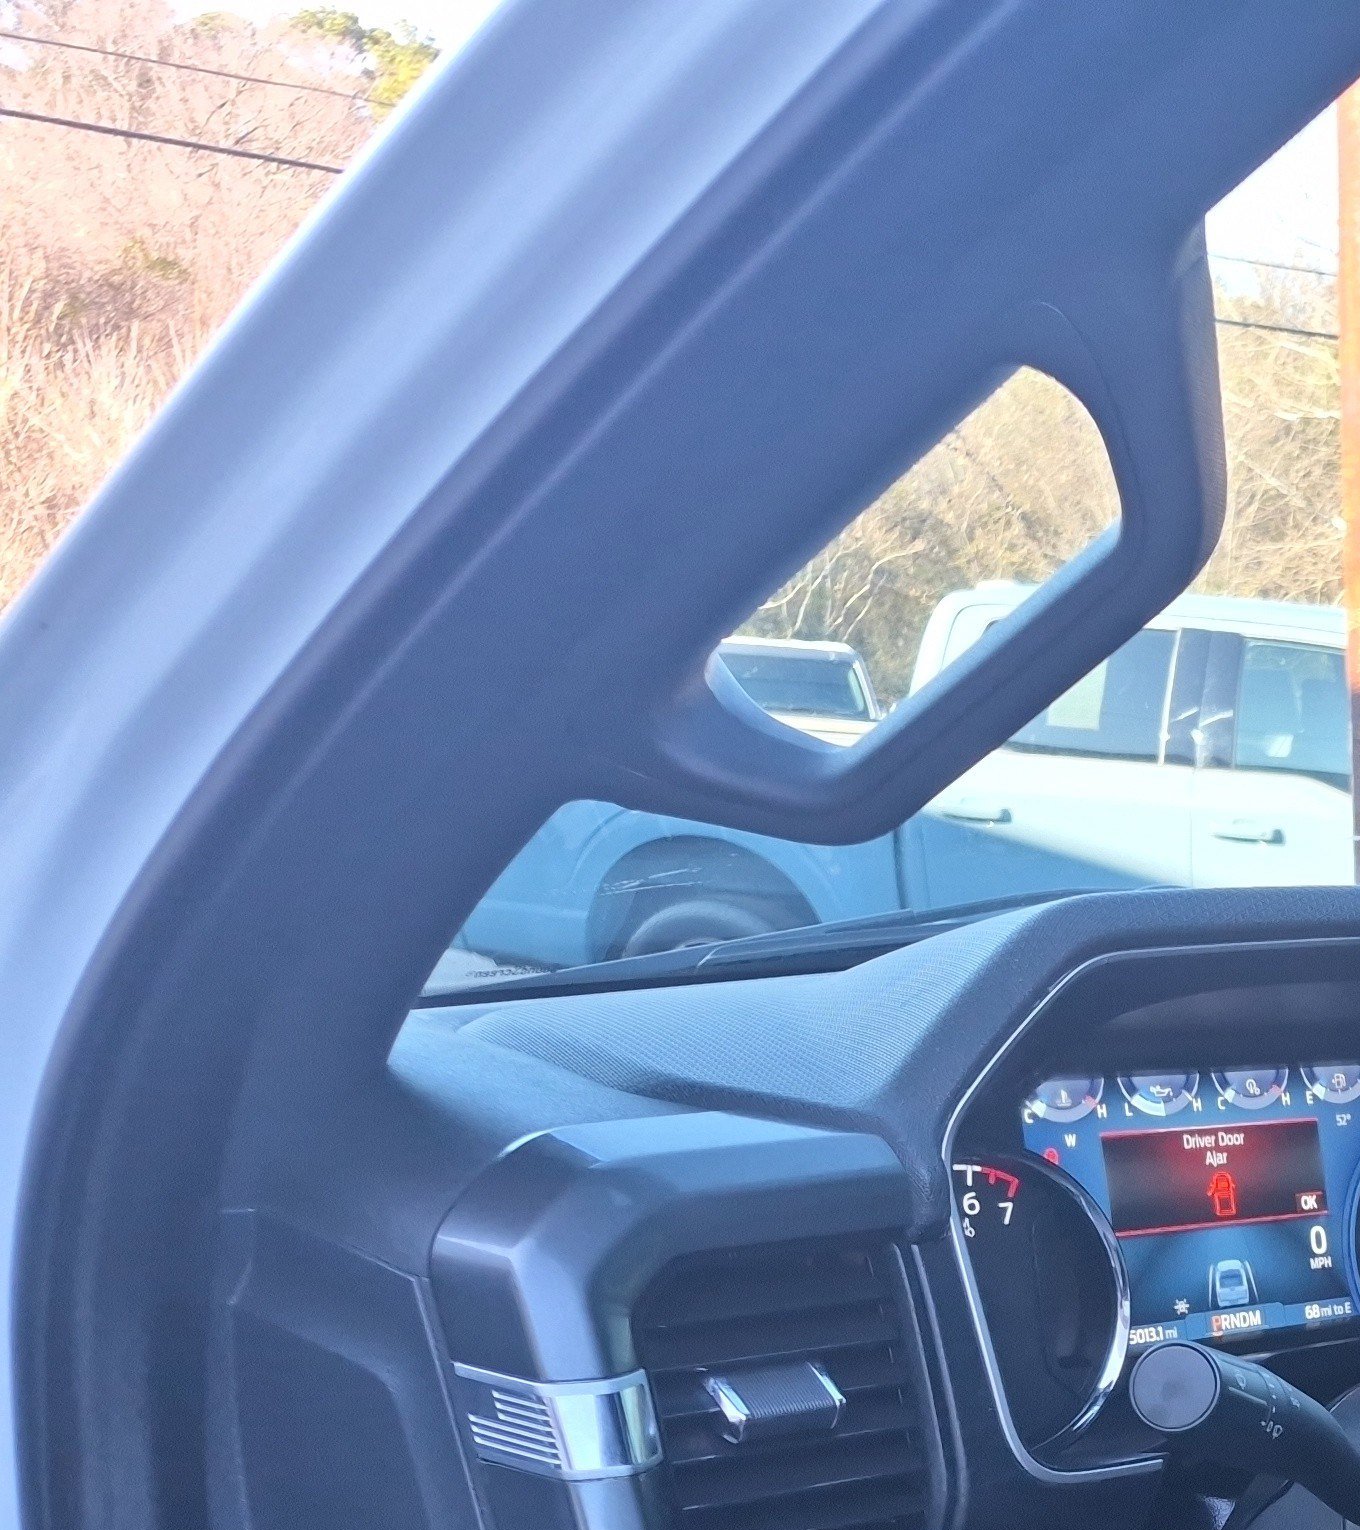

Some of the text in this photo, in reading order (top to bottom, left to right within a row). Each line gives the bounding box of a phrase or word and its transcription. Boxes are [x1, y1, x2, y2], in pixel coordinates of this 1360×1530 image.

[1192, 1097, 1203, 1112] H
[1217, 1096, 1226, 1110] C
[1281, 1091, 1291, 1106] H
[1305, 1090, 1315, 1105] E
[1096, 1103, 1108, 1119] H
[1124, 1102, 1134, 1117] L
[1182, 1131, 1245, 1150] Driver Door
[1204, 1150, 1228, 1168] Ajar
[962, 1191, 981, 1216] 6
[1300, 1194, 1318, 1211] OK
[997, 1201, 1014, 1226] 7
[1309, 1225, 1328, 1255] 0
[1309, 1255, 1332, 1271] MPH
[1304, 1301, 1352, 1320] 68 mi to E
[1165, 1326, 1178, 1340] mi
